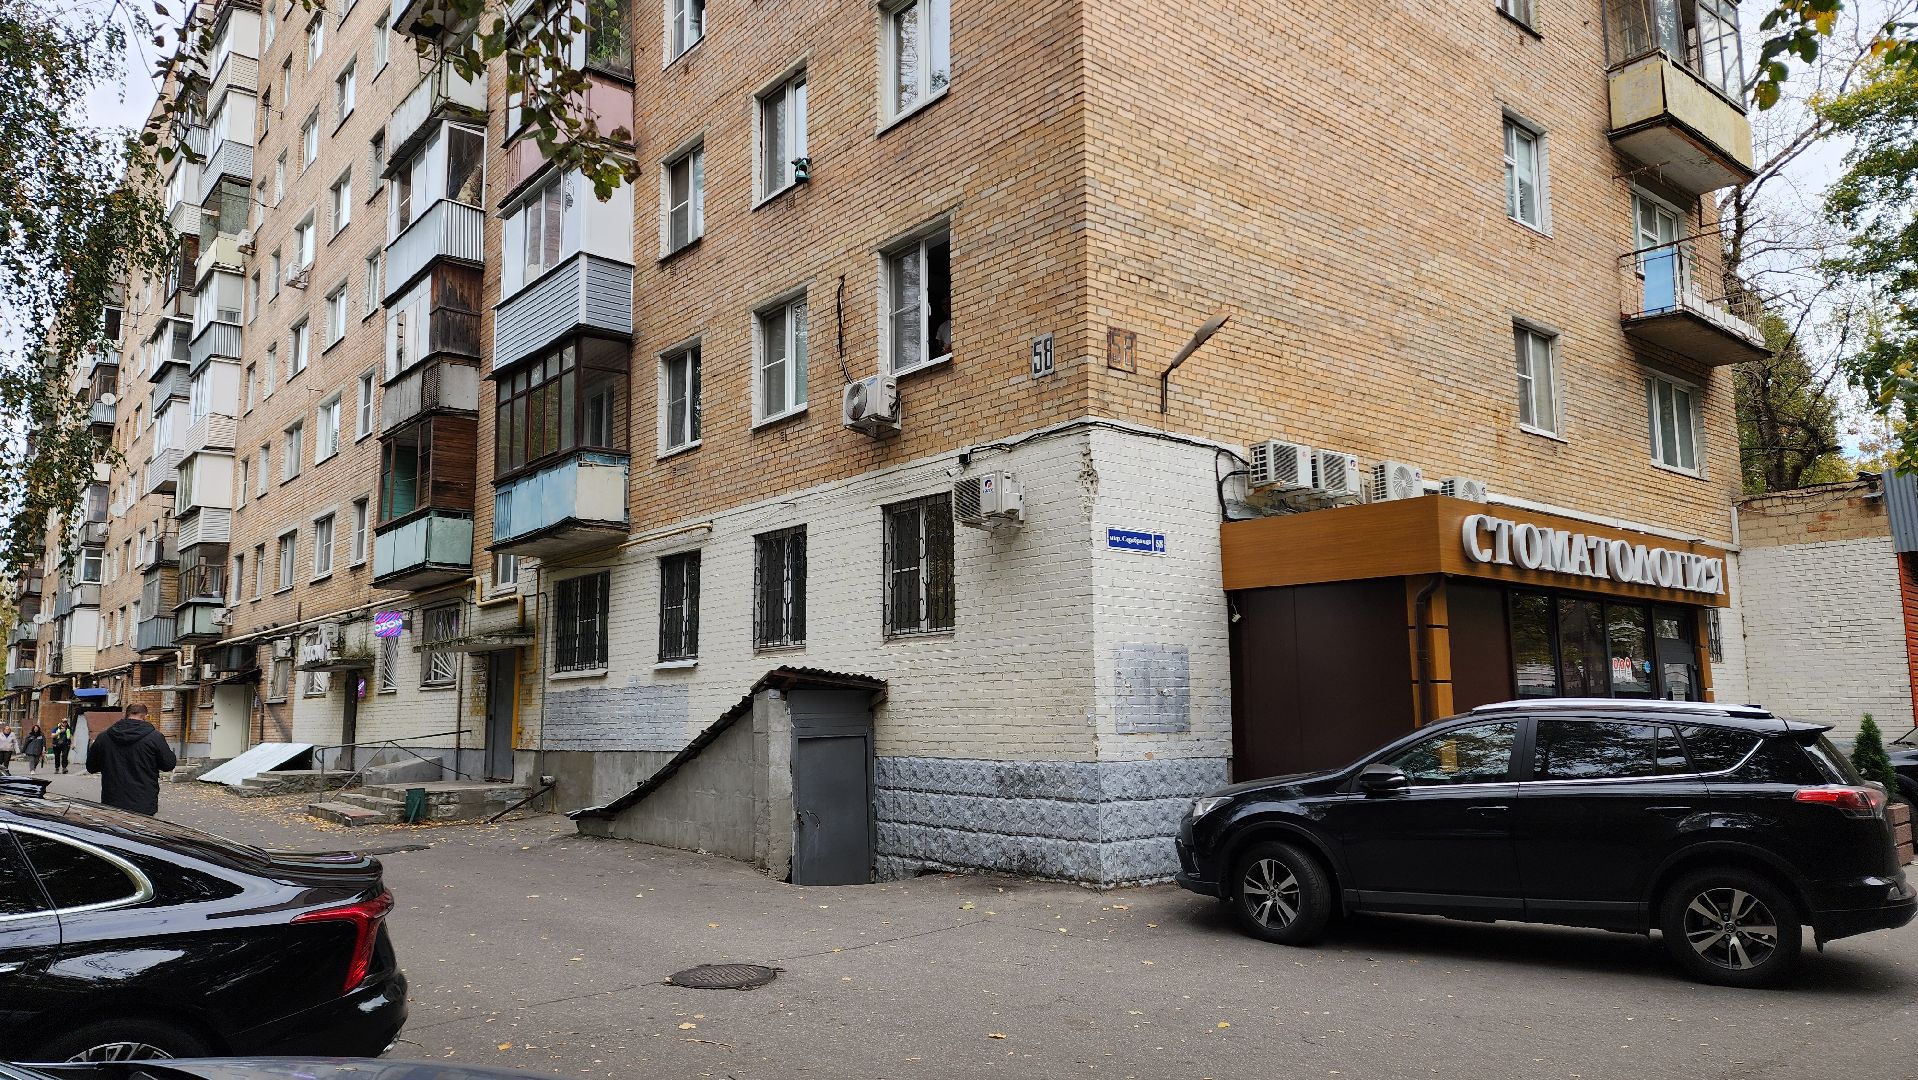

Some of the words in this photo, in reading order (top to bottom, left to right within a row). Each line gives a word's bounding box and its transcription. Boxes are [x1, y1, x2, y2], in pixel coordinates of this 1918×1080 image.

[1033, 338, 1053, 374] 58
[1462, 514, 1725, 595] СТОМАТОЛОГИЯ
[374, 619, 403, 632] OZON
